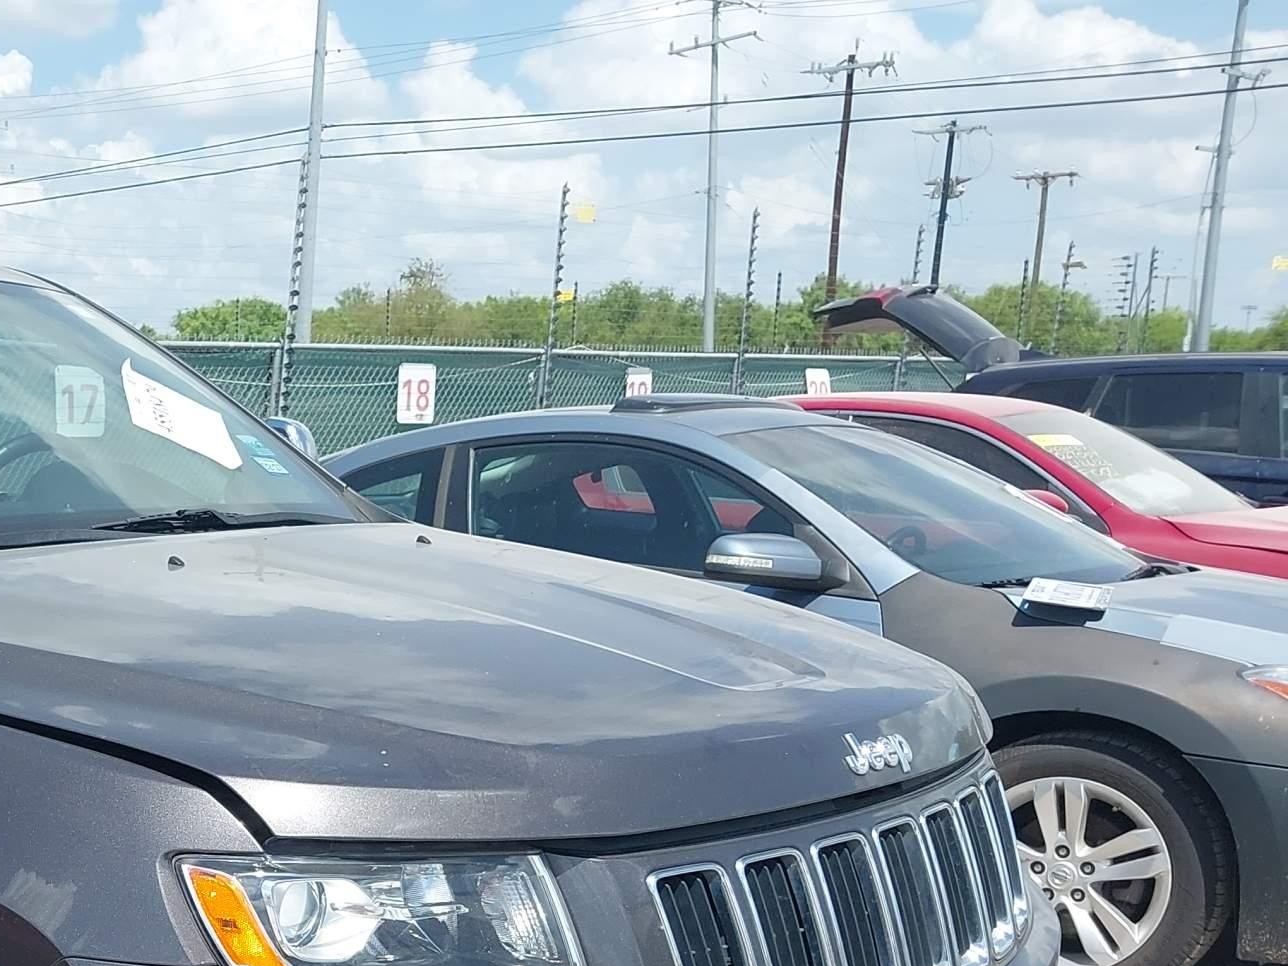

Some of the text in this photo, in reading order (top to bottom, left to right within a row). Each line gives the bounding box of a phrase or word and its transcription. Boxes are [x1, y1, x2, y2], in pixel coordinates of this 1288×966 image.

[62, 383, 99, 424] 17
[402, 379, 430, 412] 18
[840, 732, 913, 775] Jeep
